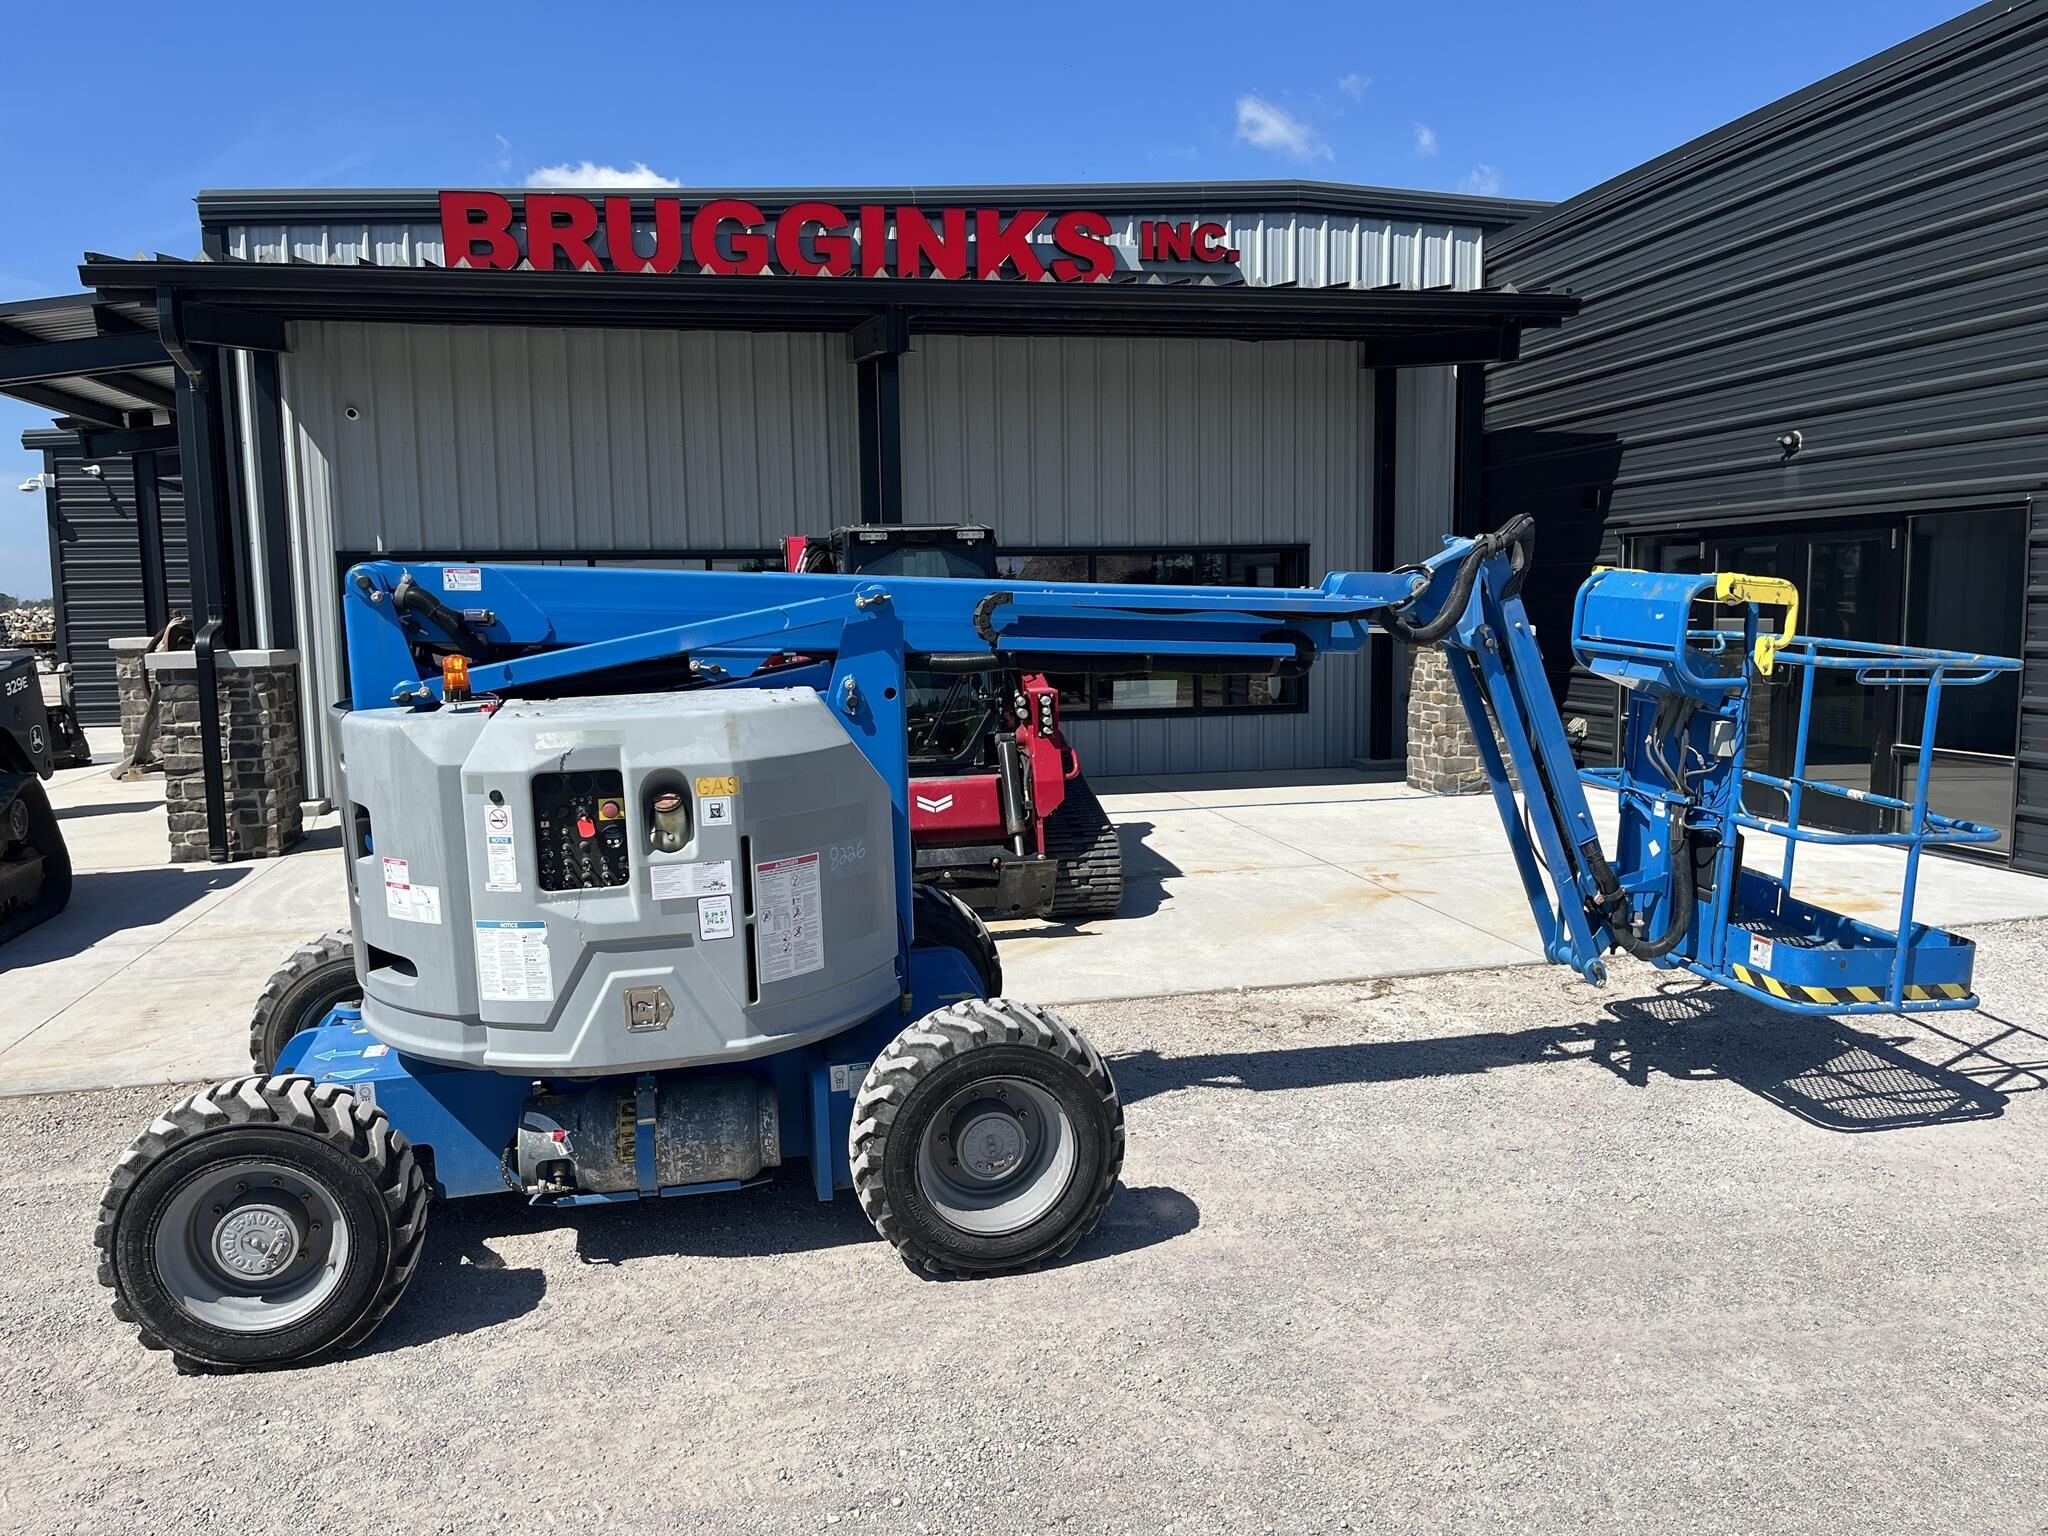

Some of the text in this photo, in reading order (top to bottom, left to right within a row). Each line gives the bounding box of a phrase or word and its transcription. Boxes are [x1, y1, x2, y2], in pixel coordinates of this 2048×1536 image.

[439, 190, 1241, 284] BRUGGINKS INC.
[5, 676, 29, 697] 329E
[698, 776, 737, 795] GAS
[830, 840, 866, 872] 8226
[222, 1213, 279, 1272] TORQUE-HUB
